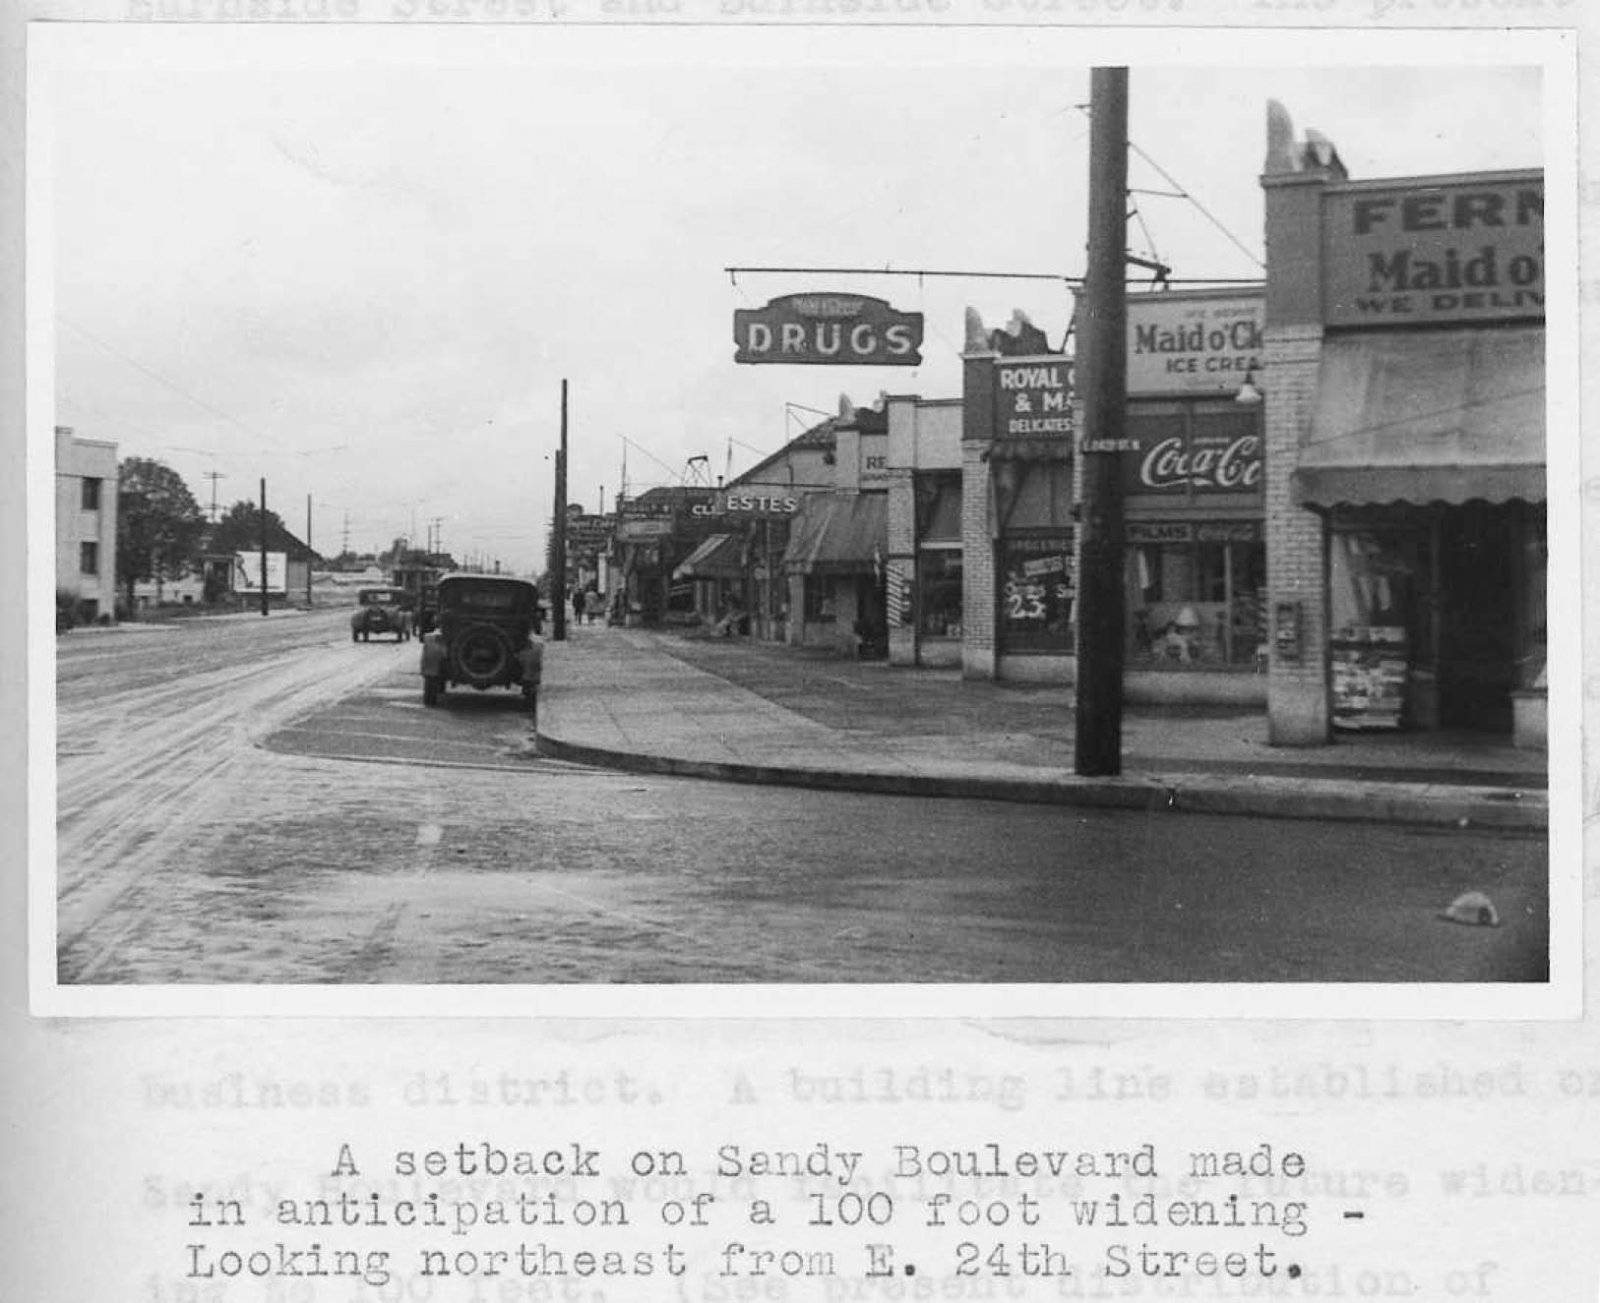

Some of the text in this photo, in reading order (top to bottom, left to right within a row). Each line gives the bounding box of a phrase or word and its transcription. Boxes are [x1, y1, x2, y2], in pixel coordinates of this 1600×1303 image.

[1368, 247, 1500, 293] Maid
[1356, 297, 1412, 313] WE
[749, 323, 911, 354] DRUGS
[1135, 323, 1203, 354] Maid
[1001, 368, 1063, 389] ROYAL
[1166, 358, 1198, 373] ICE
[1015, 393, 1031, 412] &
[727, 496, 797, 513] ESTES
[332, 1143, 1305, 1186] A setback on Sandy Boulevard made
[188, 1192, 246, 1227] in
[277, 1192, 630, 1236] anticipation
[661, 1193, 715, 1227] of
[750, 1201, 776, 1225] a
[809, 1192, 894, 1227] 100
[926, 1193, 1041, 1227] foot
[1073, 1193, 1308, 1237] widening
[187, 1243, 1303, 1286] Looking northeast from E. 24th Street.
